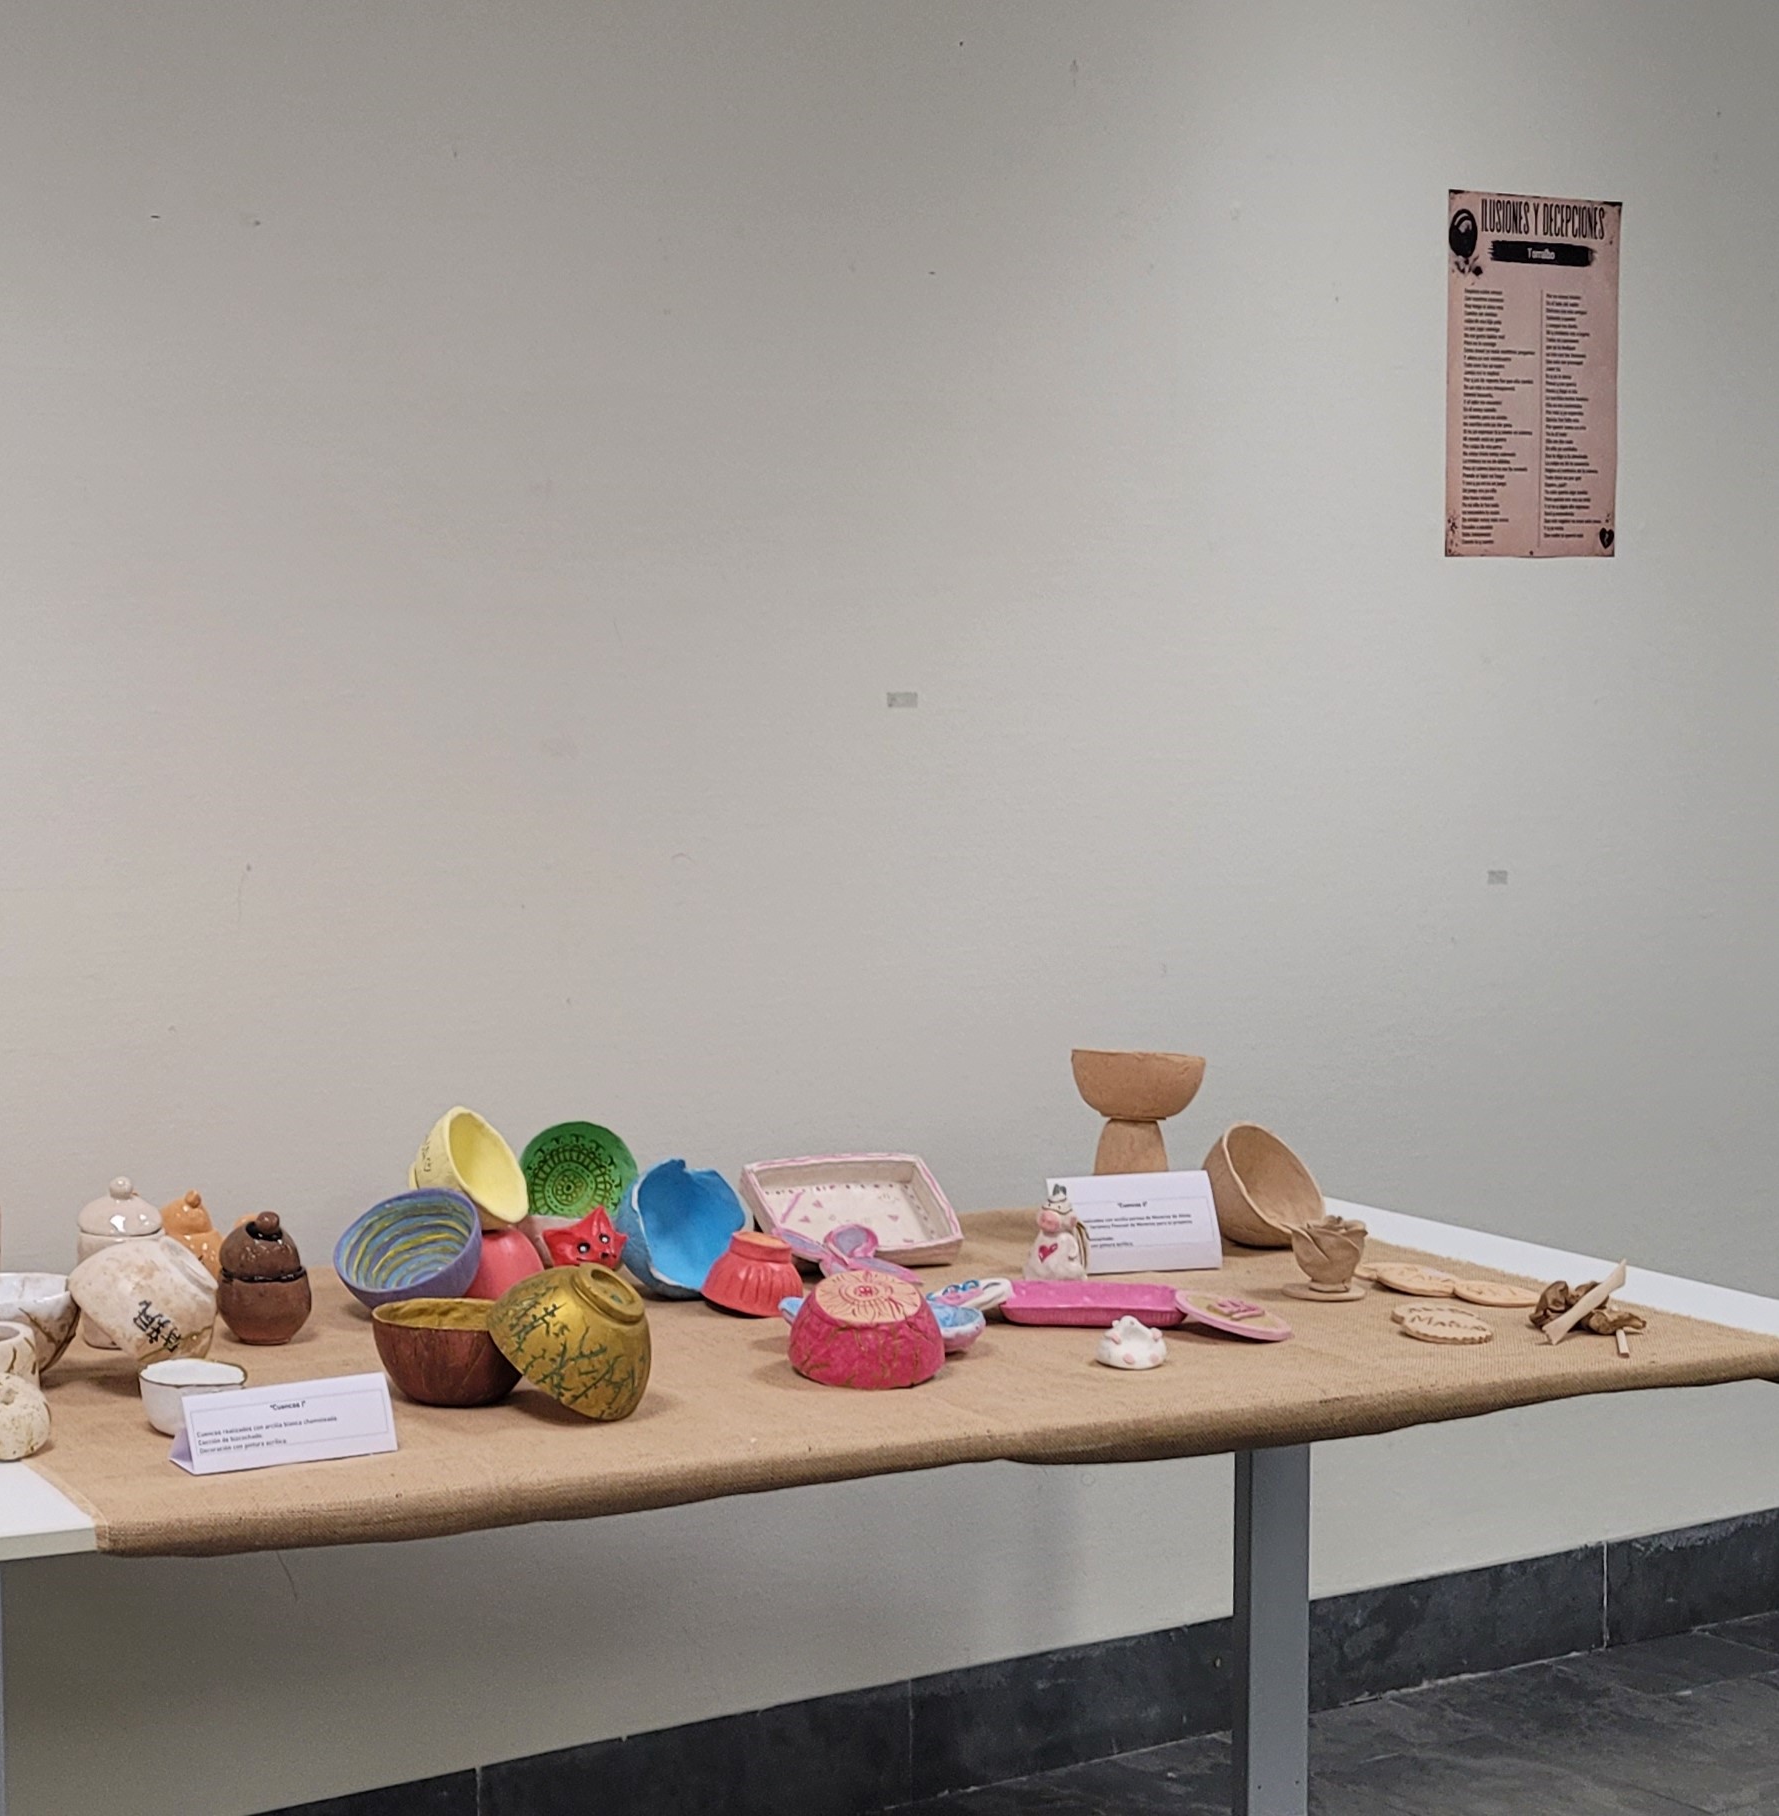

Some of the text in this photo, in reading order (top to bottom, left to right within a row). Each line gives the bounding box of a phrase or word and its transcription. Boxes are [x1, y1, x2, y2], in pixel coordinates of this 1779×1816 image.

[1481, 199, 1605, 240] ILUSIONES Y DECEPCIONES
